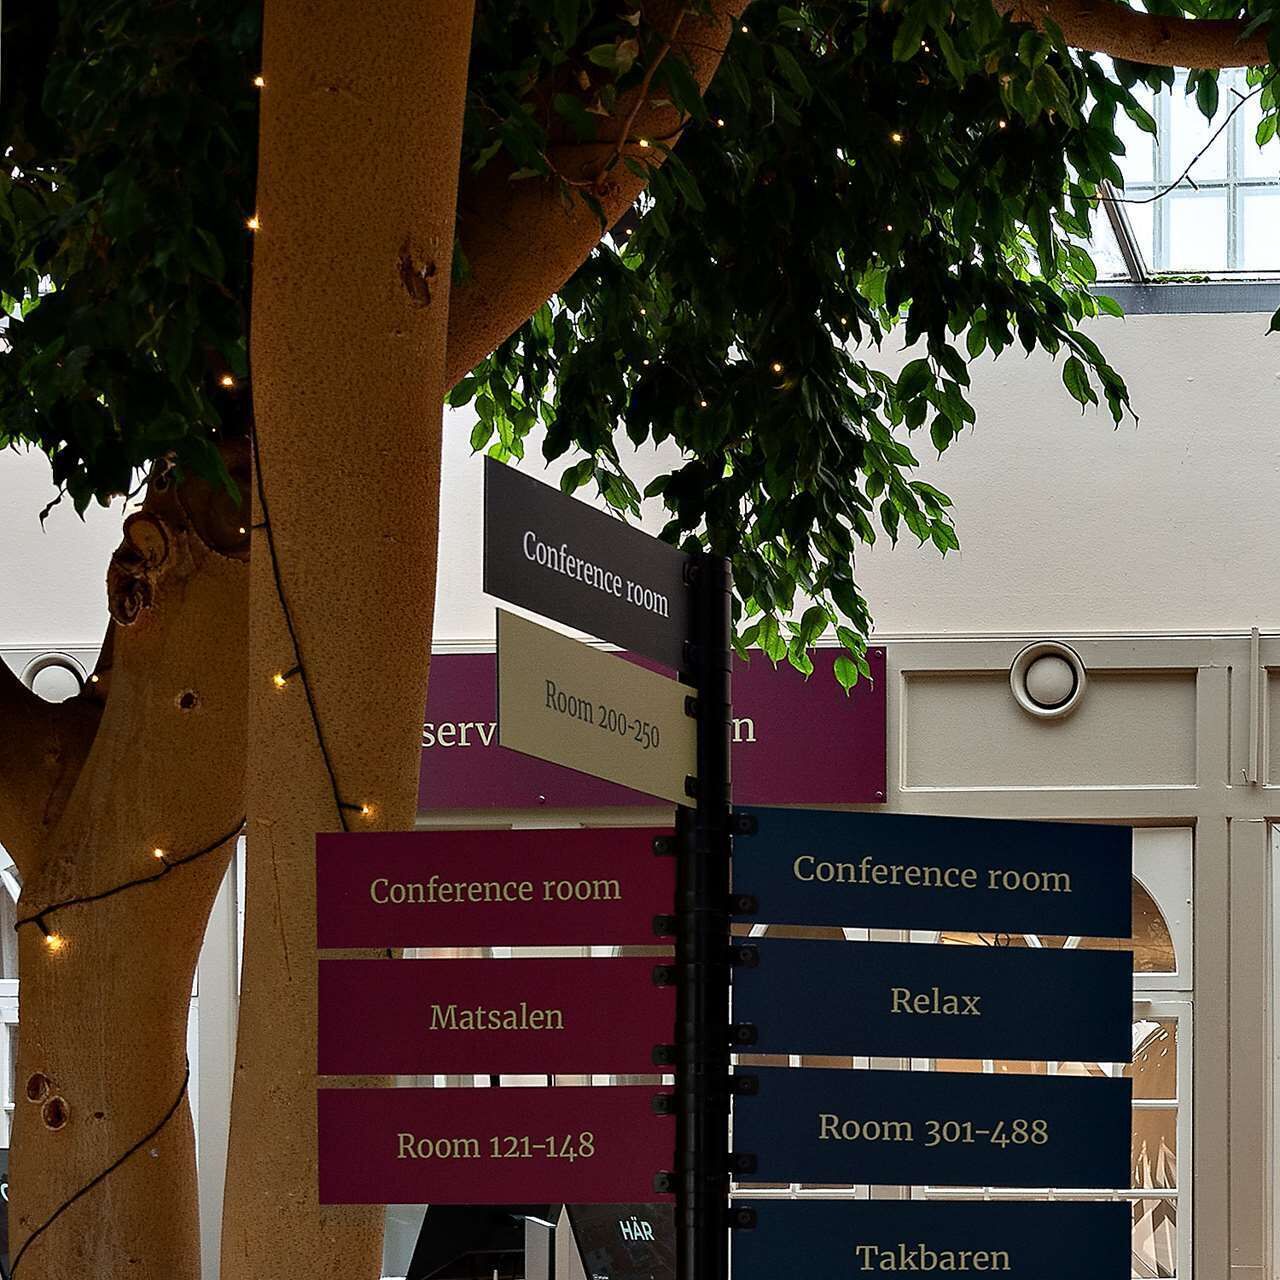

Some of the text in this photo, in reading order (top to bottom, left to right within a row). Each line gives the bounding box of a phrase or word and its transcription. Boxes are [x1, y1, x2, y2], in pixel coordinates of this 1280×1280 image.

[523, 531, 670, 618] Conference room
[545, 680, 660, 749] Room 200-250
[793, 855, 1072, 893] Conference room
[370, 876, 622, 904] Conference room
[429, 1002, 564, 1030] Matsalen
[890, 987, 981, 1016] Relax
[818, 1113, 1049, 1148] Room 301-488
[397, 1131, 595, 1162] Room 121-148
[619, 1216, 655, 1240] HÄR
[855, 1243, 1011, 1271] Takbaren
